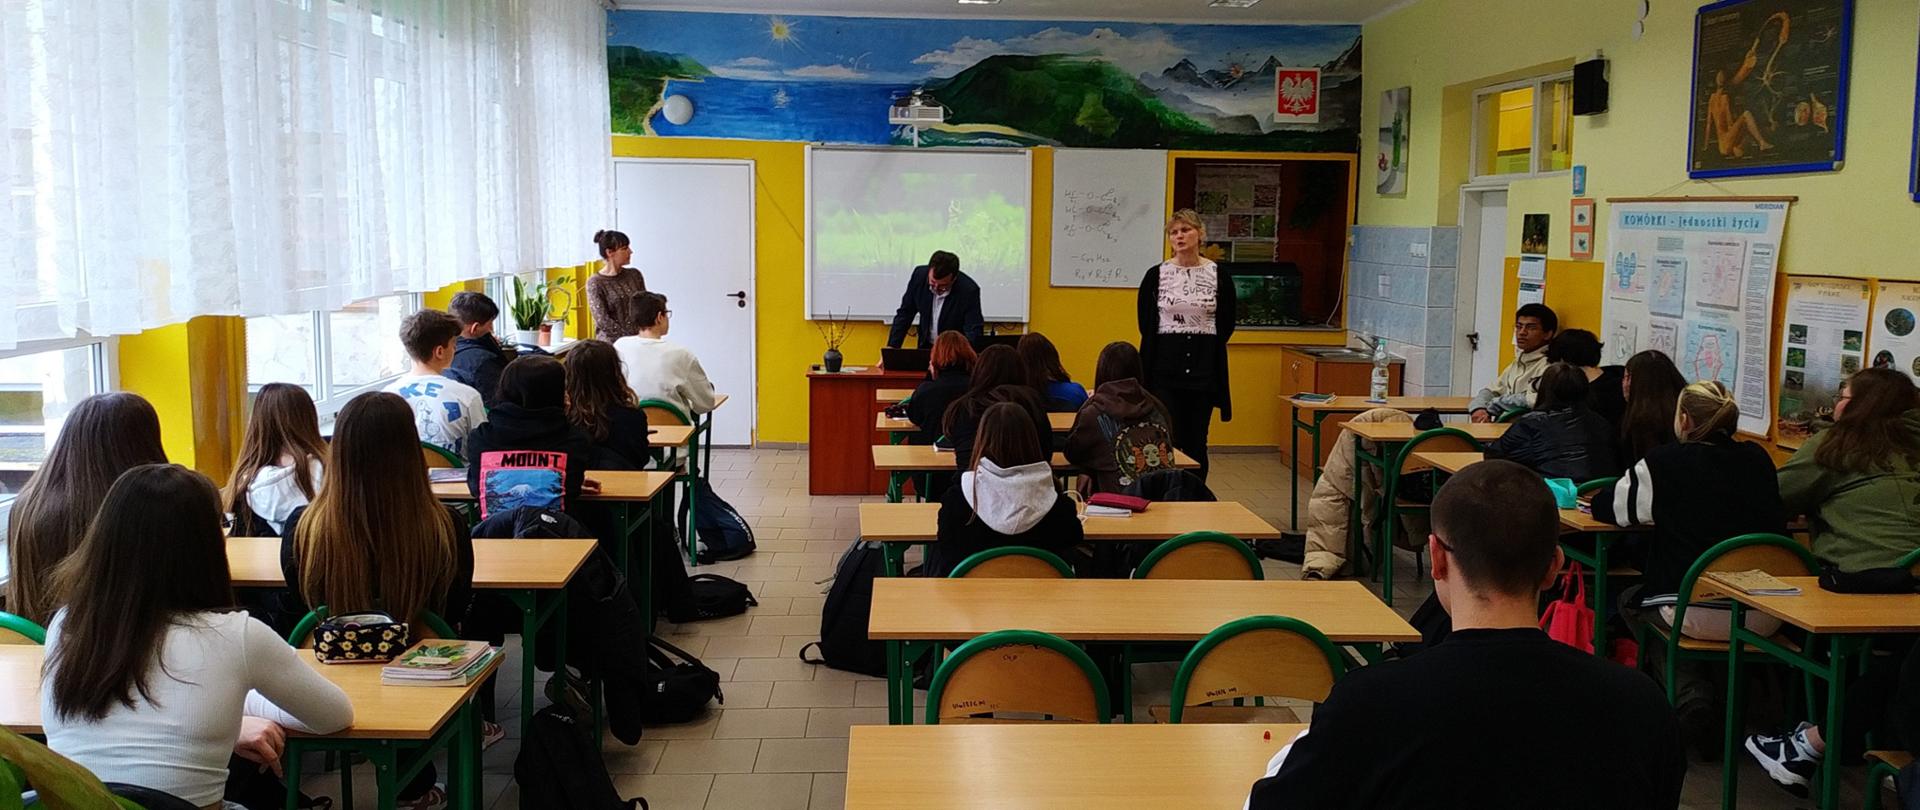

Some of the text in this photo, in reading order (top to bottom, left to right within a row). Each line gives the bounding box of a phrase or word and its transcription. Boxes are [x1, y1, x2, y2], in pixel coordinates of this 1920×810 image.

[1624, 212, 1667, 227] KOMÓRKI
[1678, 214, 1727, 228] jednostki
[1732, 216, 1760, 230] życia
[501, 453, 562, 467] MOUNT
